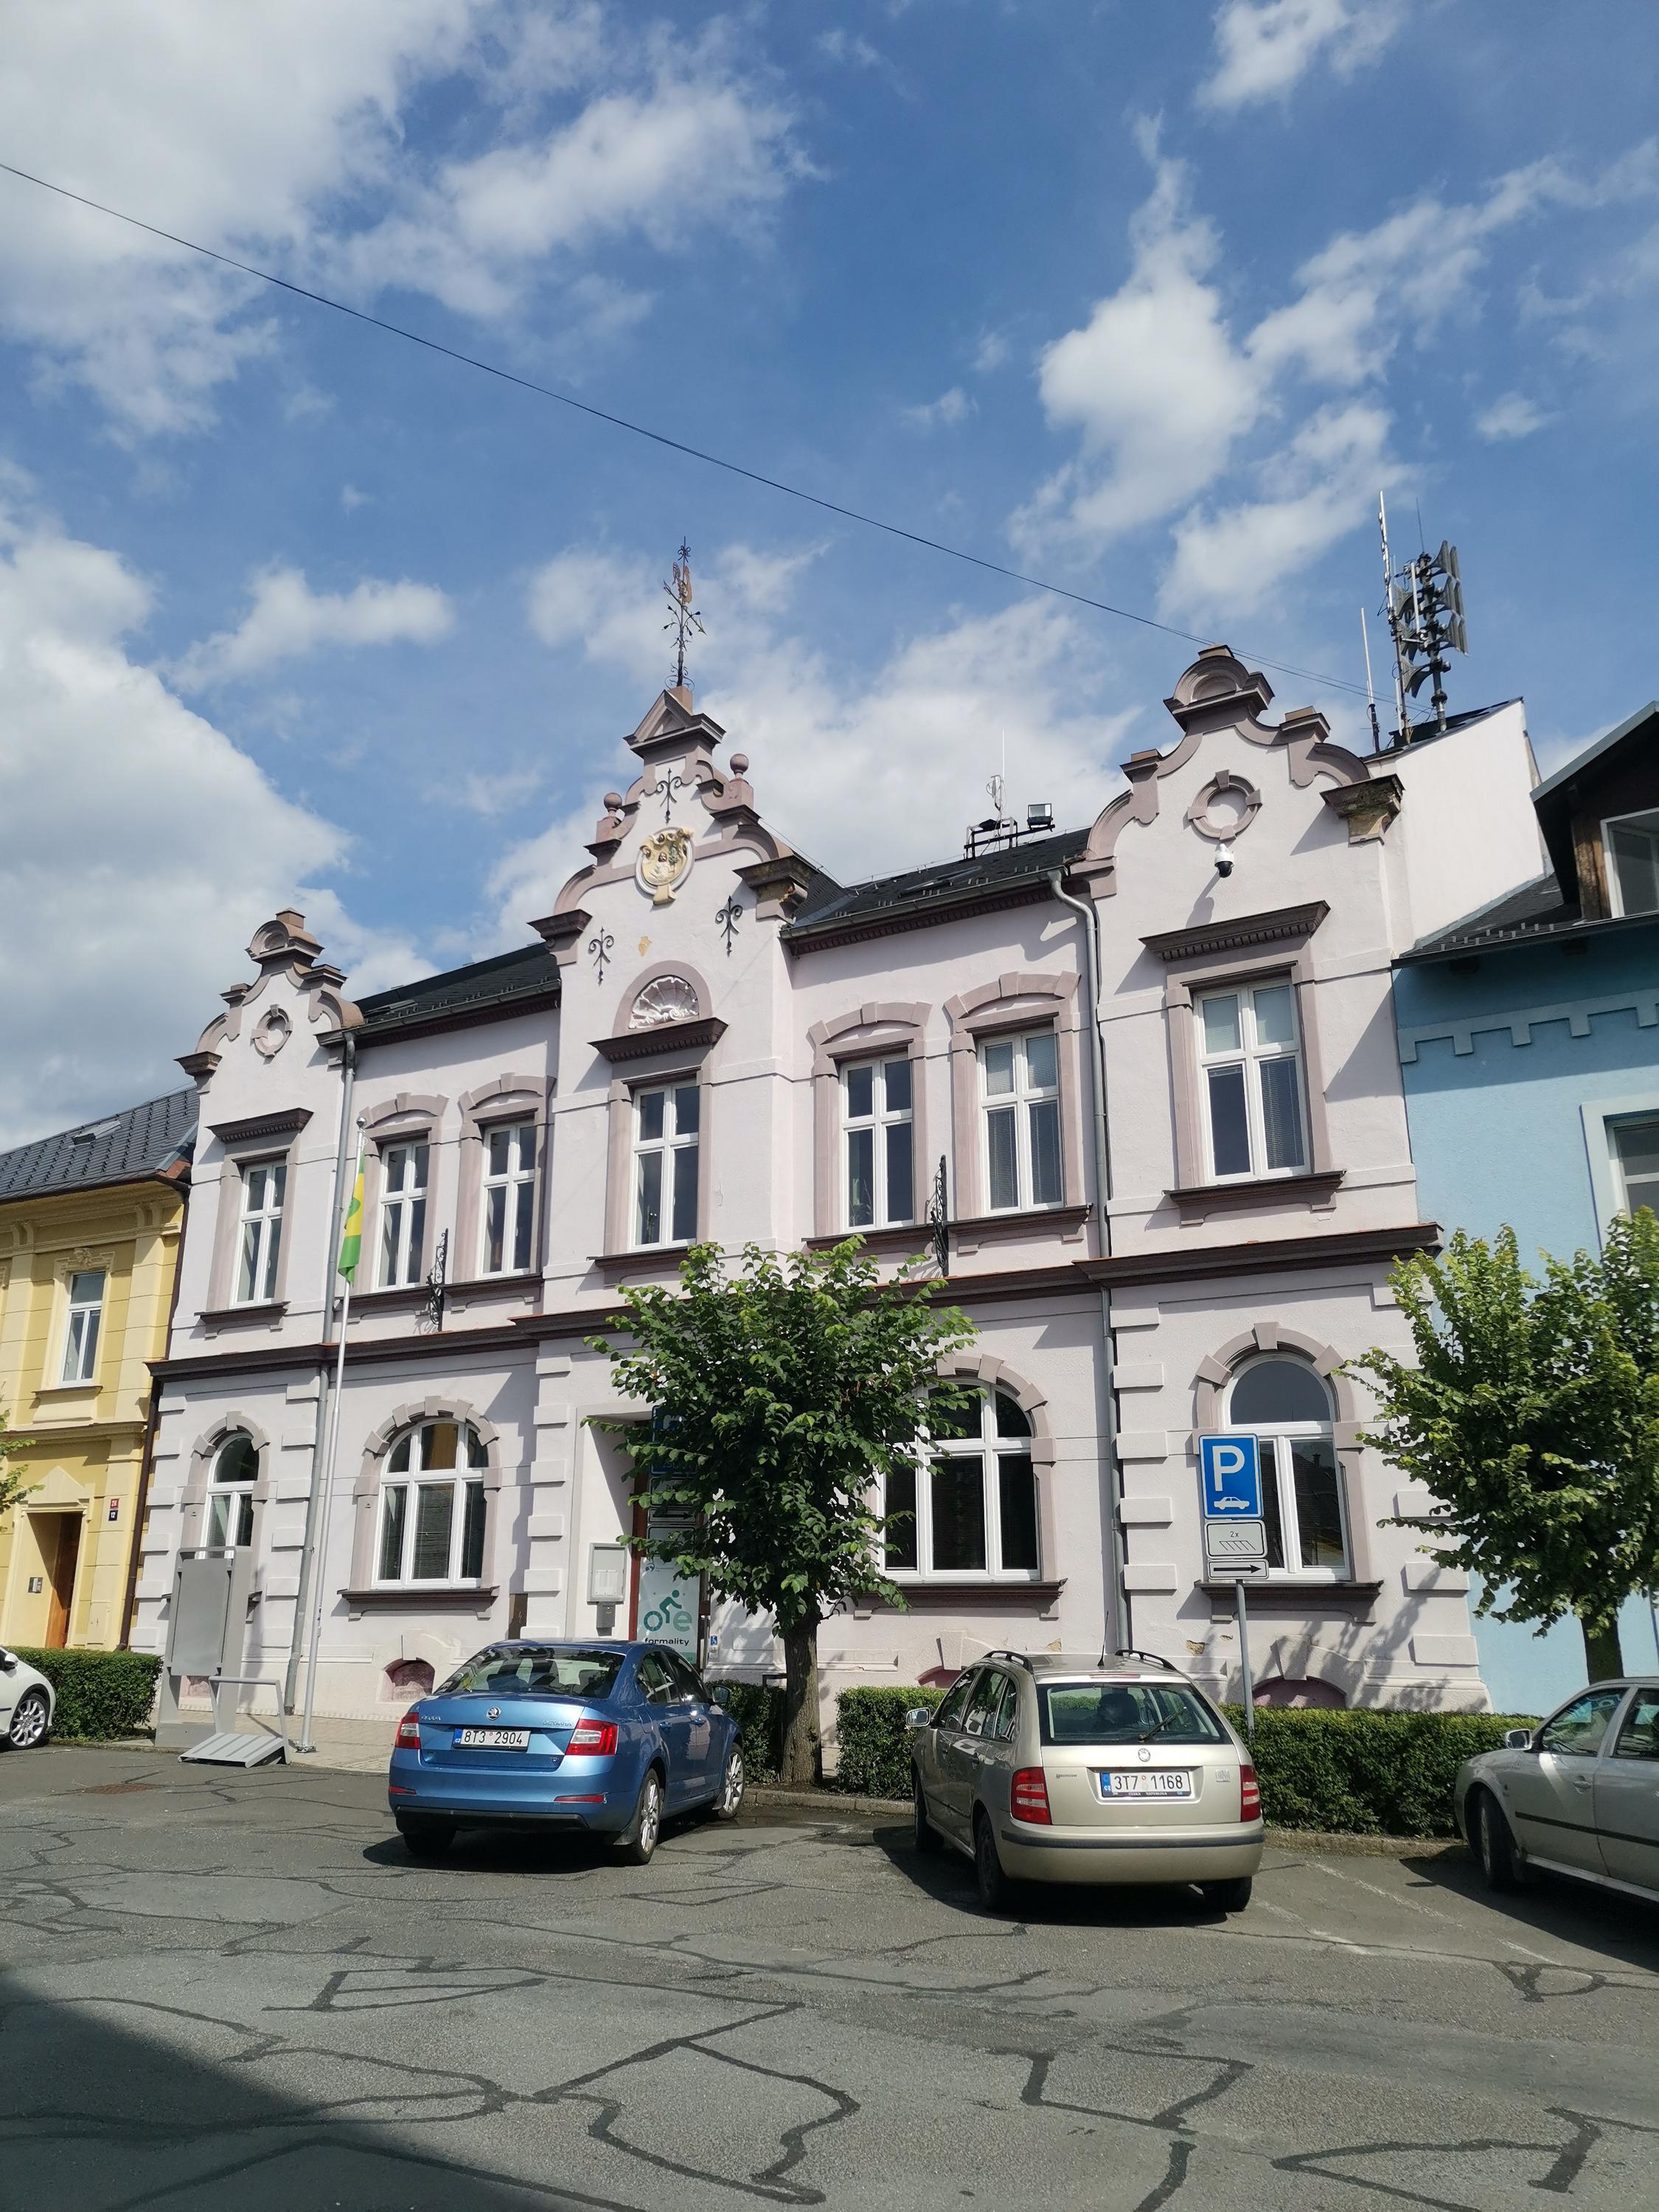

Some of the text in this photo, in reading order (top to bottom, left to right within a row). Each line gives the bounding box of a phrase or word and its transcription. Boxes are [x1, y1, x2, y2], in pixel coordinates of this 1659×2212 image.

[1212, 1445, 1245, 1492] P
[645, 1638, 689, 1646] formality
[465, 1731, 486, 1743] 8T3
[494, 1731, 523, 1745] 2904
[1114, 1775, 1138, 1790] 3T7
[1151, 1775, 1183, 1790] 1168
